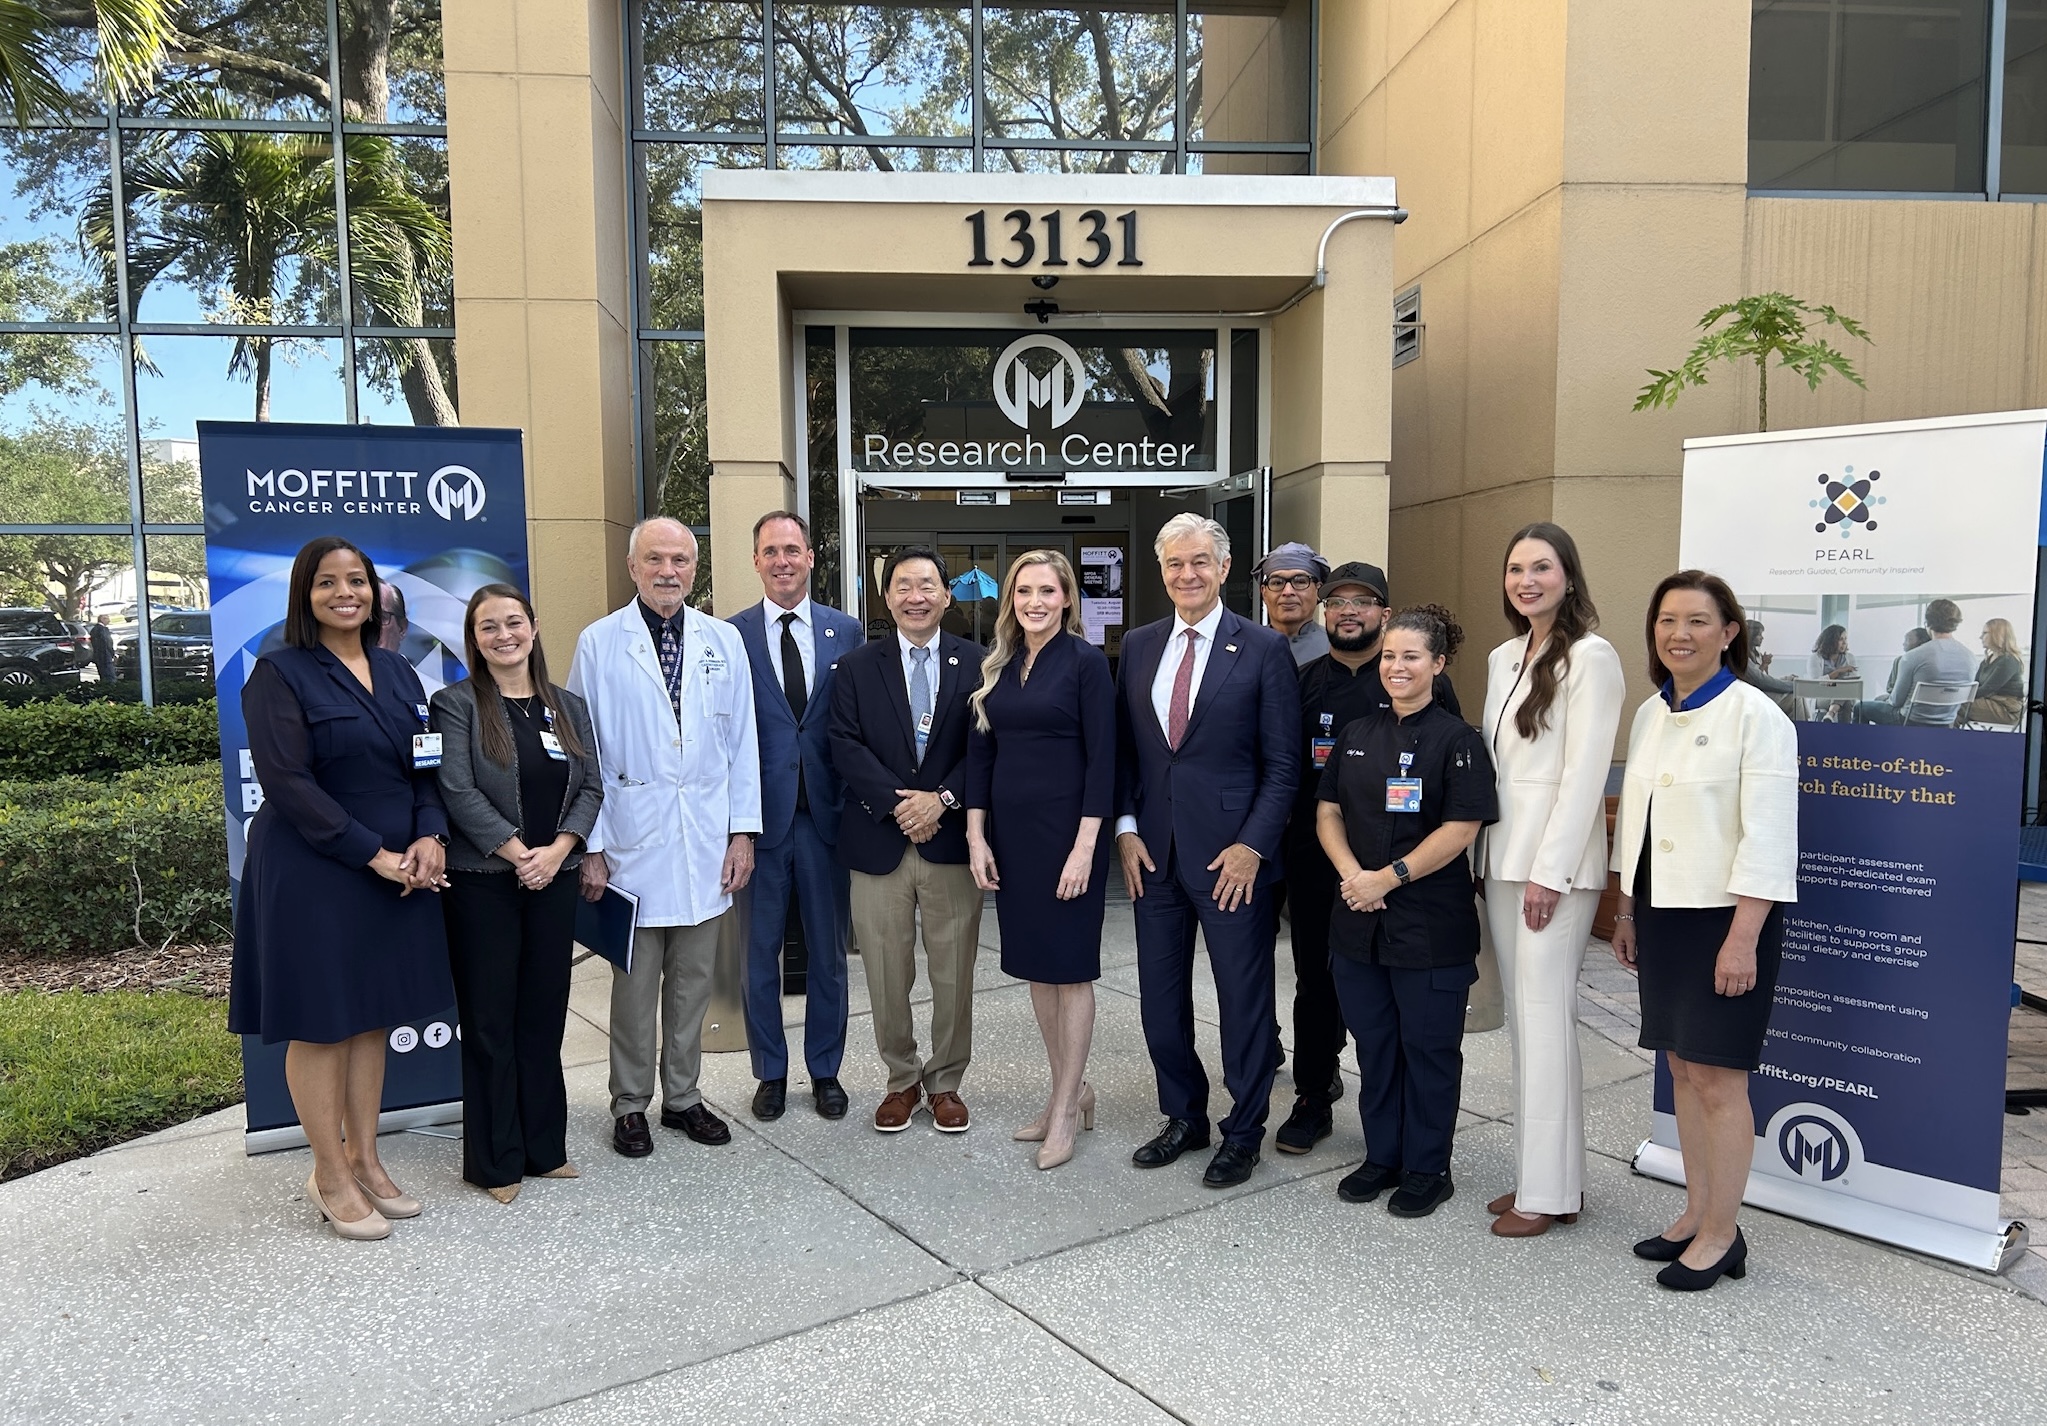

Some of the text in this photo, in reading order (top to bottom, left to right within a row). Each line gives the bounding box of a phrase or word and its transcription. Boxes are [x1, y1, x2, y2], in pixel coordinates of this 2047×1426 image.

[965, 209, 1143, 268] 13131
[864, 433, 1194, 466] Research Center
[246, 468, 418, 498] MOFFITT
[249, 500, 421, 514] CANCER CENTER
[1816, 549, 1874, 560] PEARL
[1769, 568, 1804, 576] Research
[1840, 567, 1888, 576] Community
[1807, 756, 1817, 767] a
[1822, 755, 1953, 776] state-of-the-
[1831, 780, 1906, 803] facility
[1910, 787, 1956, 805] that
[1800, 851, 1924, 872] participant assessment
[1801, 863, 1936, 886] research-dedicated exam
[1840, 880, 1932, 897] person-centered
[1785, 928, 1928, 958] facilities to supports group
[1792, 918, 1832, 932] kitchen,
[1834, 924, 1866, 937] dining
[1868, 930, 1898, 941] room
[1900, 935, 1922, 944] and
[1812, 944, 1848, 958] dietary
[1851, 950, 1871, 960] and
[1874, 954, 1920, 968] exercise
[1833, 994, 1896, 1013] assessment
[1899, 1006, 1929, 1020] using
[1791, 1033, 1848, 1052] community
[1850, 1045, 1921, 1064] collaboration
